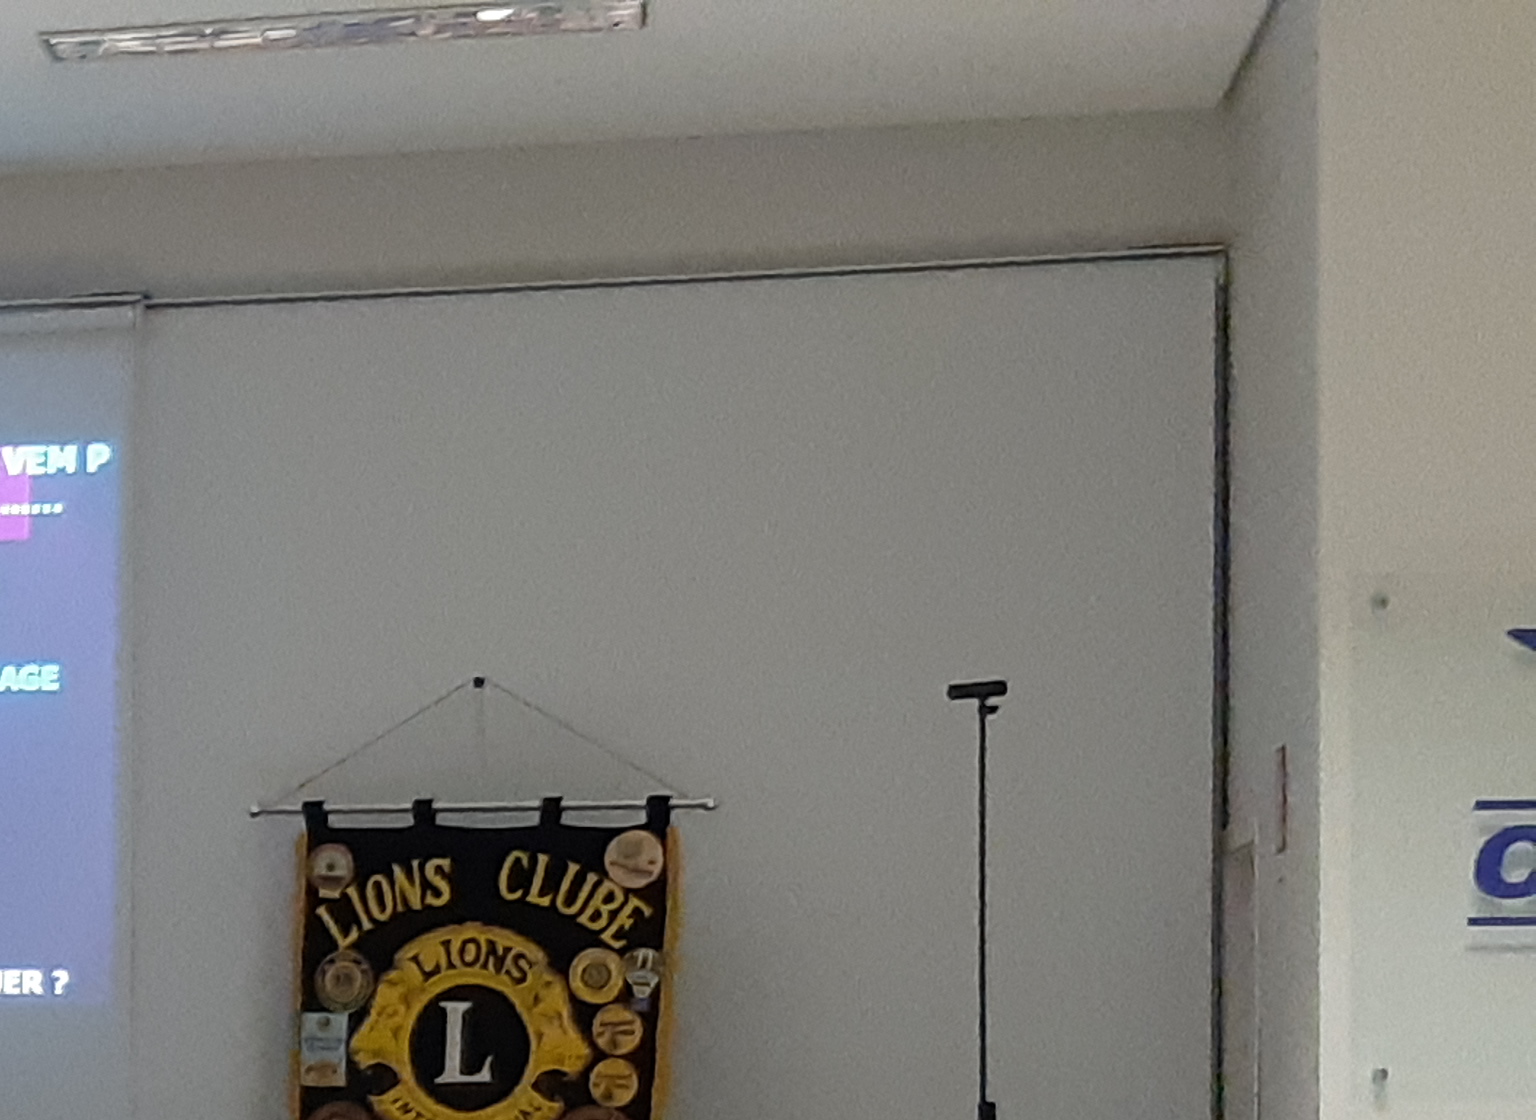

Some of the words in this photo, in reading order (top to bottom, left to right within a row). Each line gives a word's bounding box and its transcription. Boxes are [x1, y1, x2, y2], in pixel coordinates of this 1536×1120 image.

[0, 443, 79, 477] VEM
[85, 442, 112, 474] P
[315, 857, 451, 951] LIONS
[498, 850, 654, 950] CLUBE
[50, 968, 71, 996] ?
[407, 936, 533, 987] LIONS
[433, 1000, 494, 1084] L
